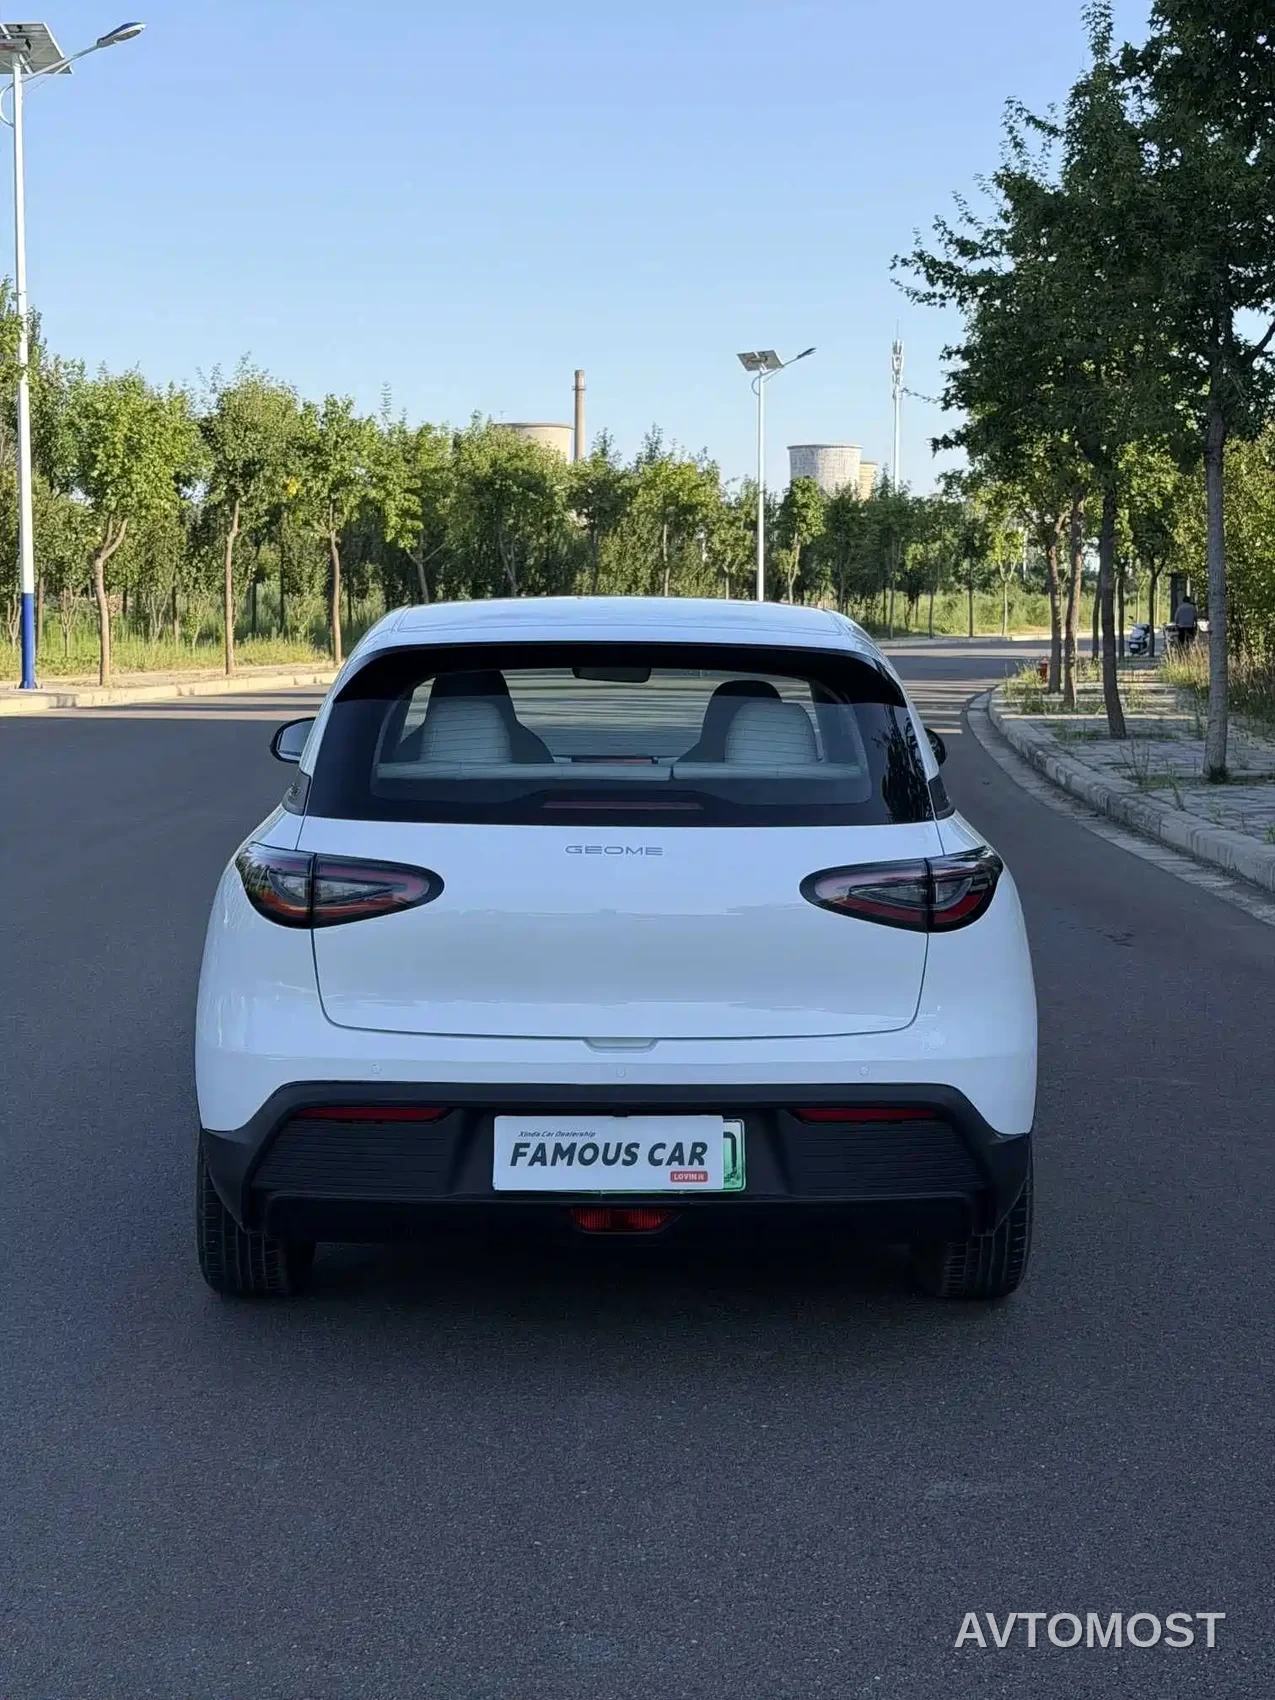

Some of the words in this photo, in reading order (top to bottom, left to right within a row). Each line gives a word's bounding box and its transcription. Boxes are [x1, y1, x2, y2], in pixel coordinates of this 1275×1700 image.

[565, 845, 663, 855] GEOME
[541, 1130, 554, 1138] Car
[554, 1130, 596, 1139] Dealership
[510, 1142, 640, 1167] FAMOUS
[648, 1142, 708, 1166] CAR
[673, 1173, 697, 1181] LOVIN
